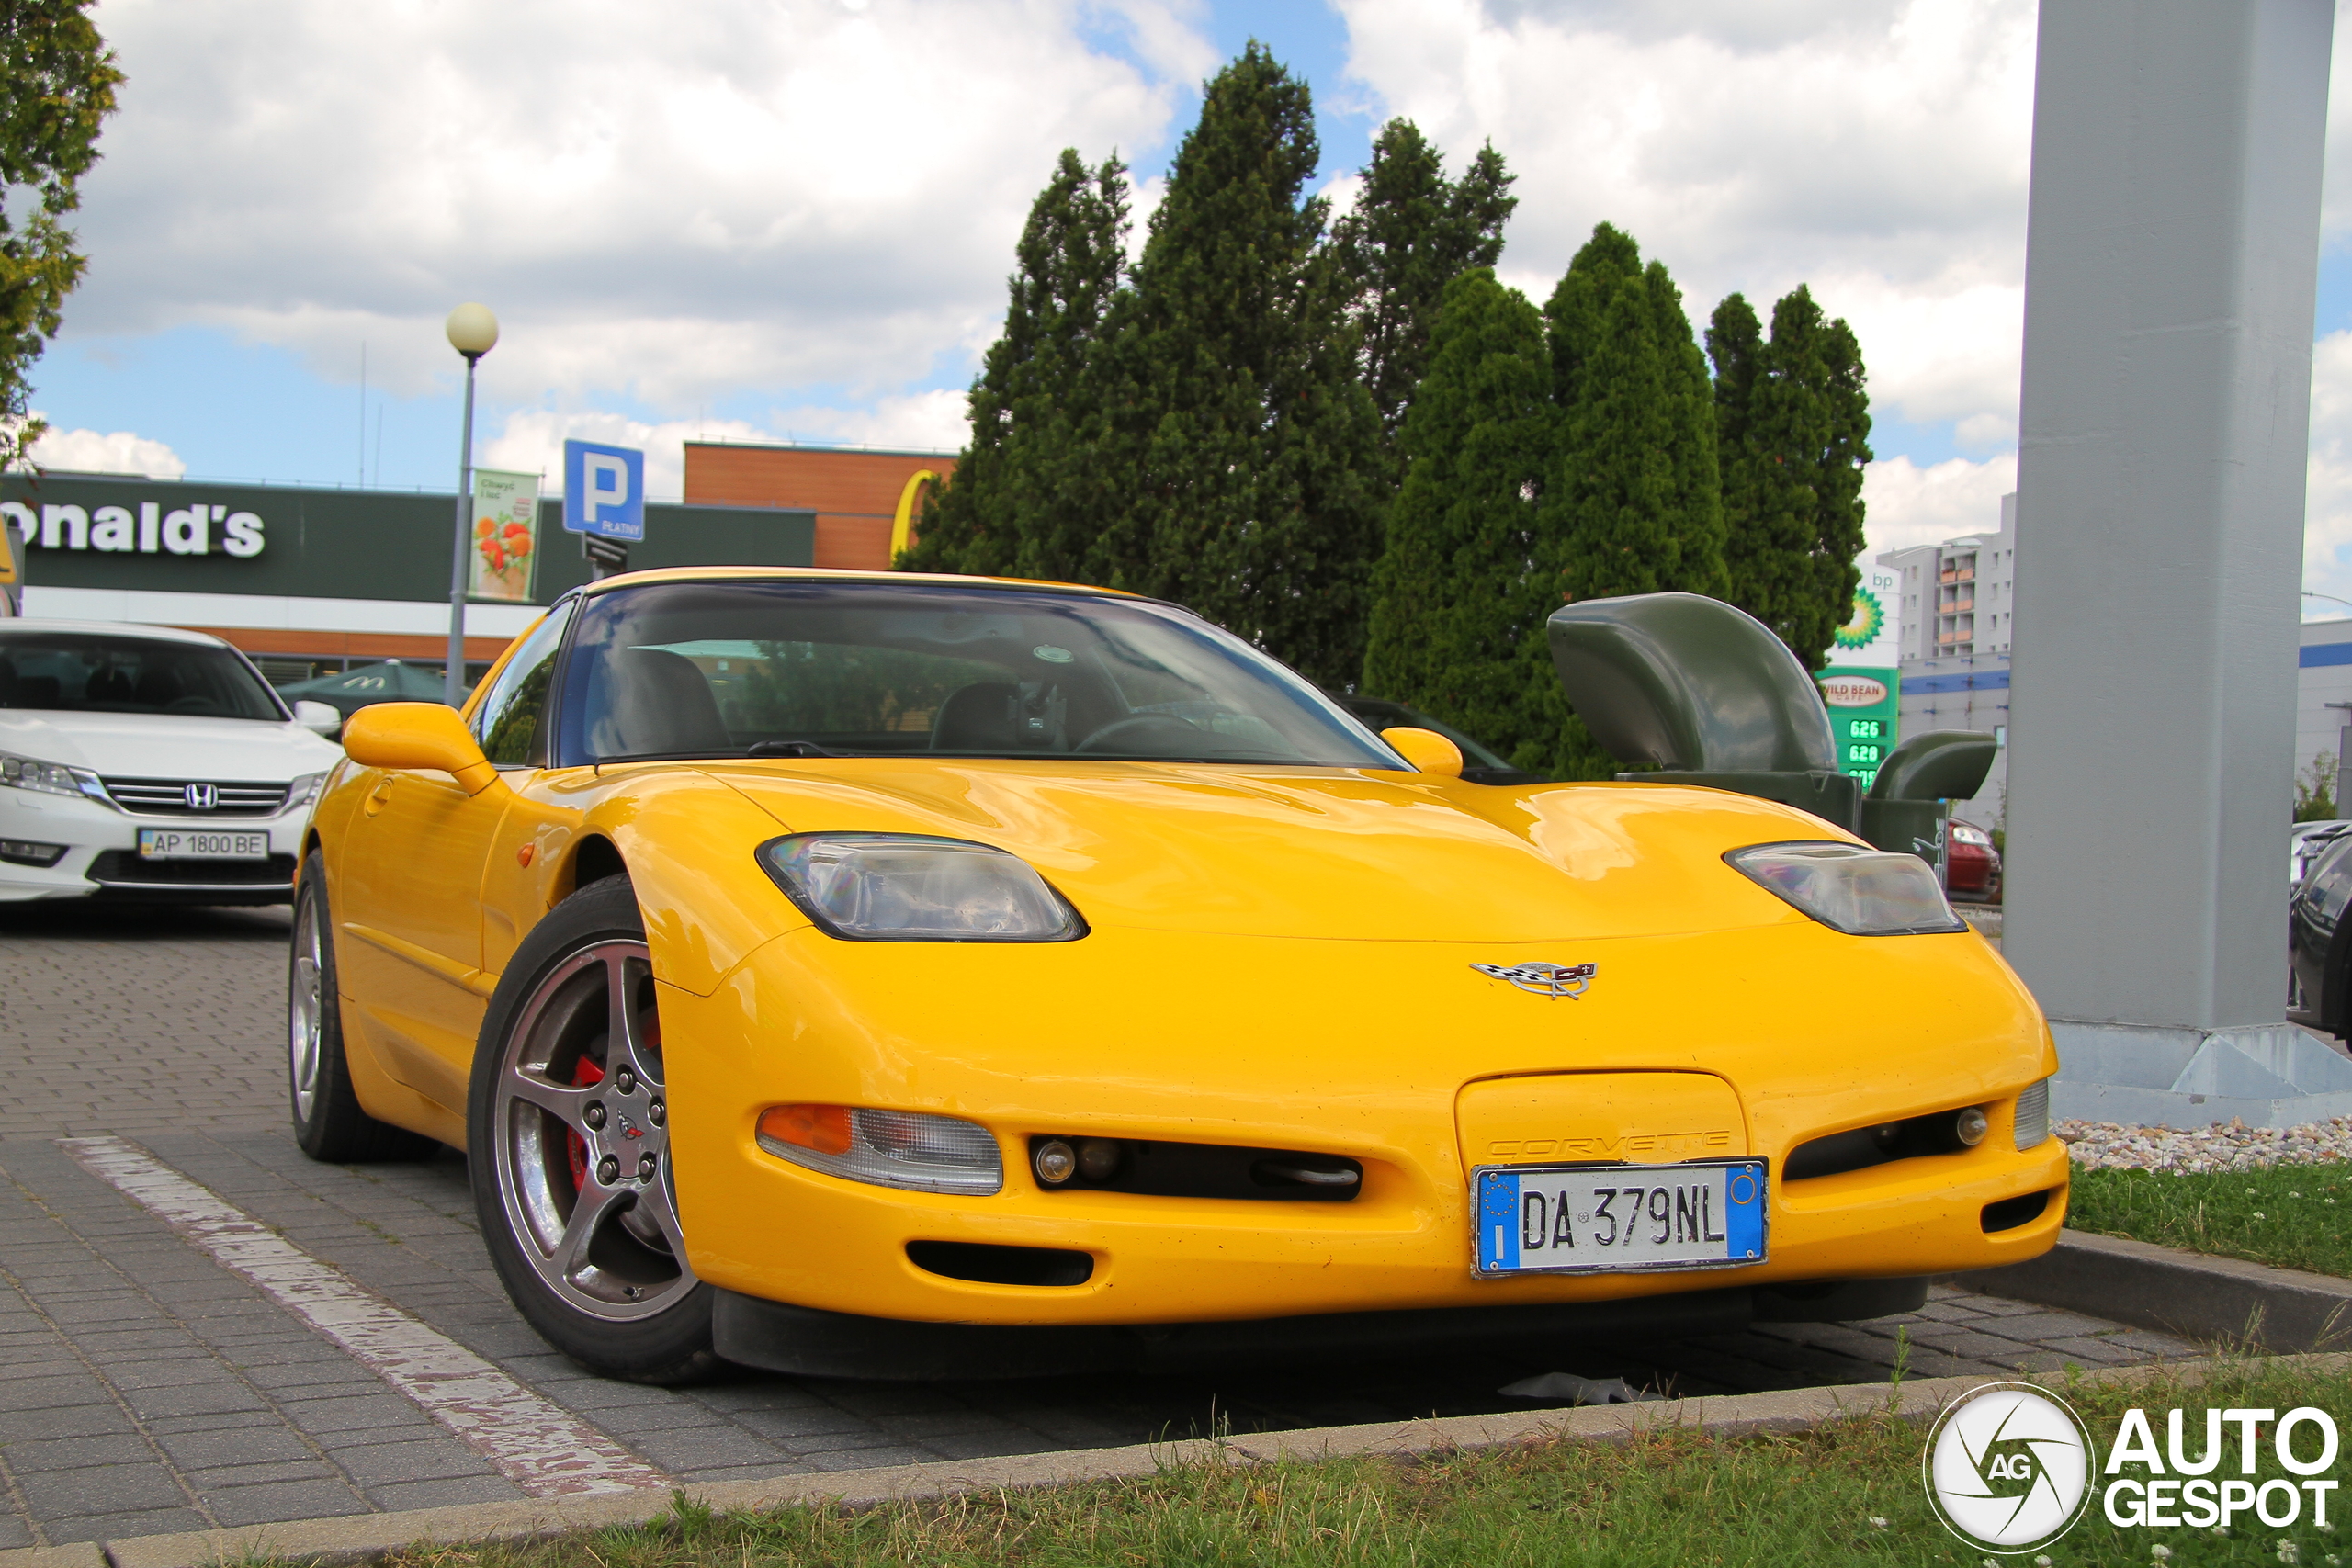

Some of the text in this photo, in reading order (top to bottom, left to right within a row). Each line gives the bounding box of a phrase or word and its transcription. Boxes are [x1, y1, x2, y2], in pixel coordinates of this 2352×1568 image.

[583, 451, 628, 524] P
[602, 520, 640, 535] PŁATNY
[1872, 573, 1893, 590] bp
[1851, 684, 1880, 695] BEAN
[154, 834, 180, 852] AP
[187, 835, 231, 852] 1800
[235, 836, 261, 853] BE
[1486, 1130, 1731, 1159] CORVETTE
[1522, 1183, 1725, 1249] DA 379NL
